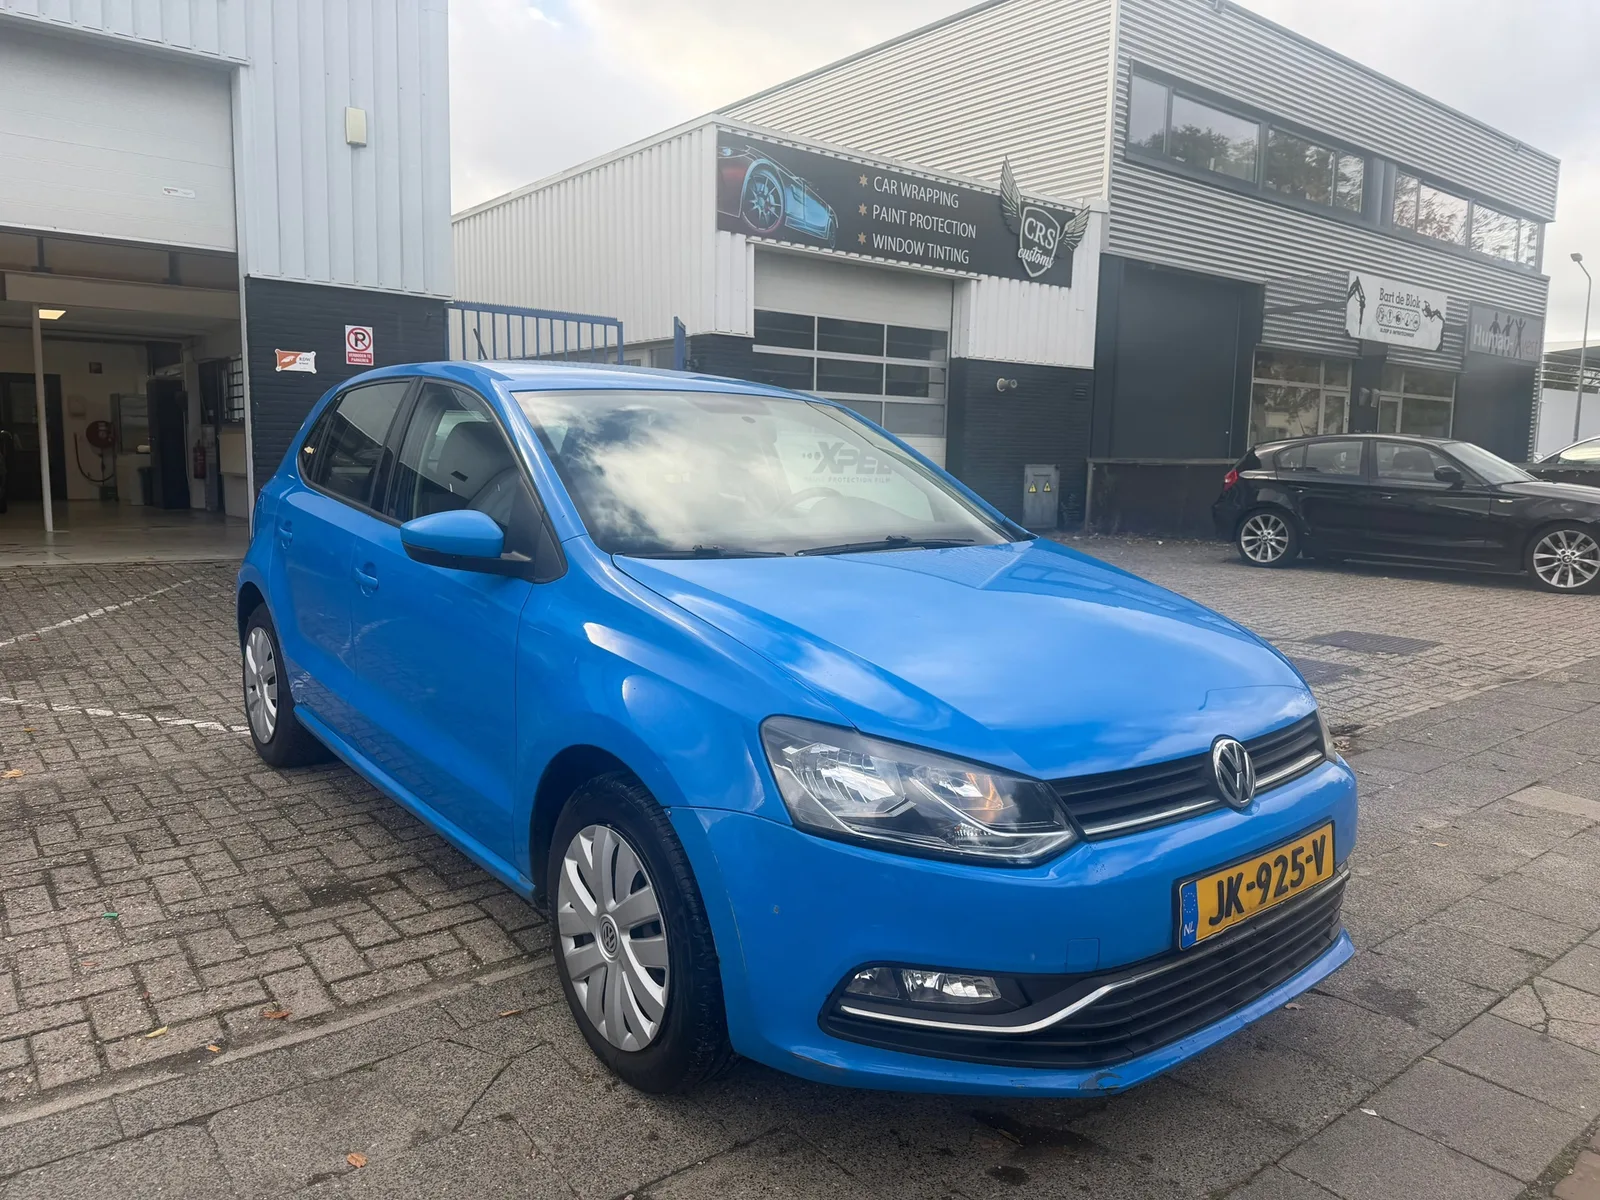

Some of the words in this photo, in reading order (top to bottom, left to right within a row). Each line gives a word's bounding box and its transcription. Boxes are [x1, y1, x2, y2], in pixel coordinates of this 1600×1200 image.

[873, 176, 898, 196] CAR
[900, 181, 959, 209] WRAPPING
[872, 204, 908, 225] PAINT
[909, 212, 977, 239] PROTECTION
[1024, 217, 1056, 250] CRS
[872, 233, 925, 256] WINDOW
[927, 243, 970, 265] TINTING
[1017, 246, 1055, 269] customs
[1379, 287, 1395, 304] Bart
[1395, 291, 1405, 306] de
[1405, 293, 1421, 309] Blok
[1208, 834, 1326, 926] JK-925-V
[1183, 922, 1195, 937] NL
